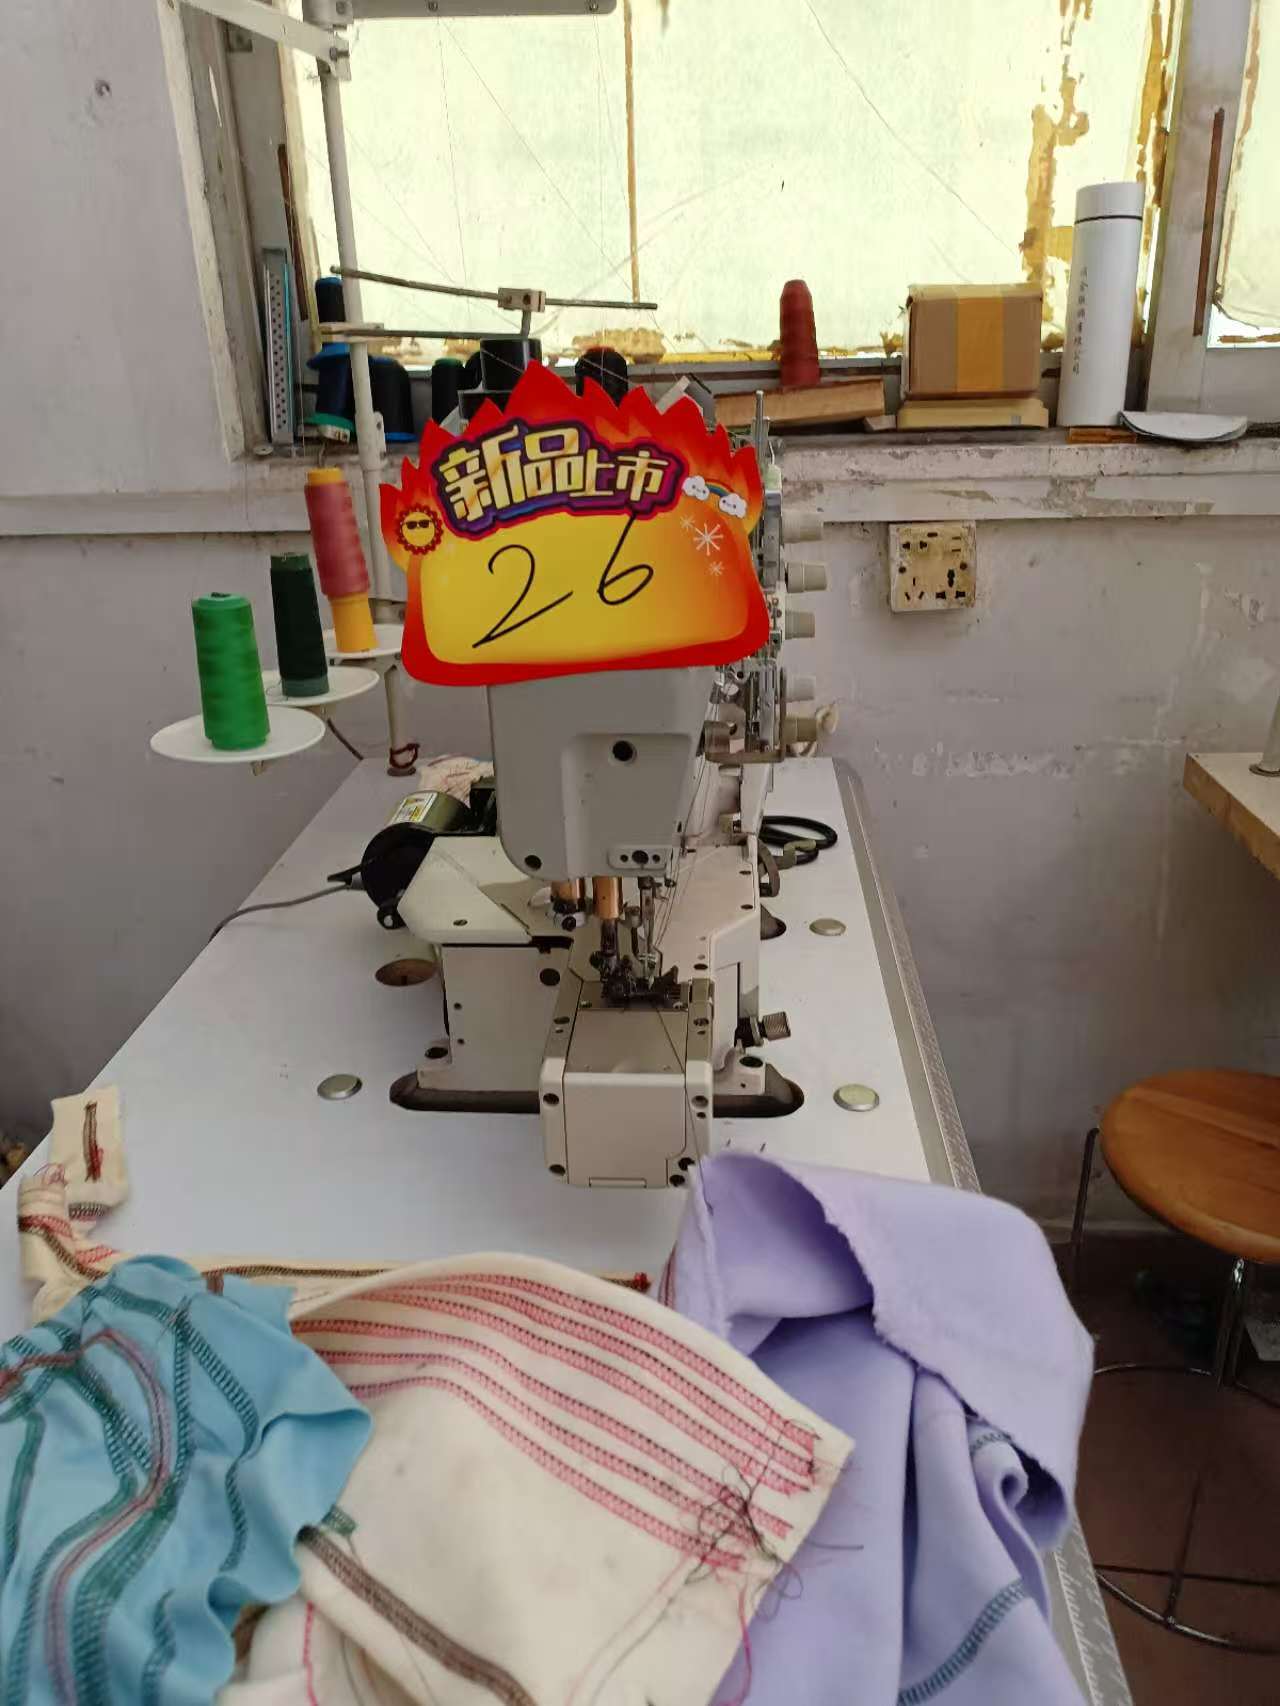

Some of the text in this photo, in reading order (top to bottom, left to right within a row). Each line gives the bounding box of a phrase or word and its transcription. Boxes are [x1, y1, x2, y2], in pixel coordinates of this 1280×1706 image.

[438, 424, 669, 522] 新品上市
[472, 514, 654, 648] 26
